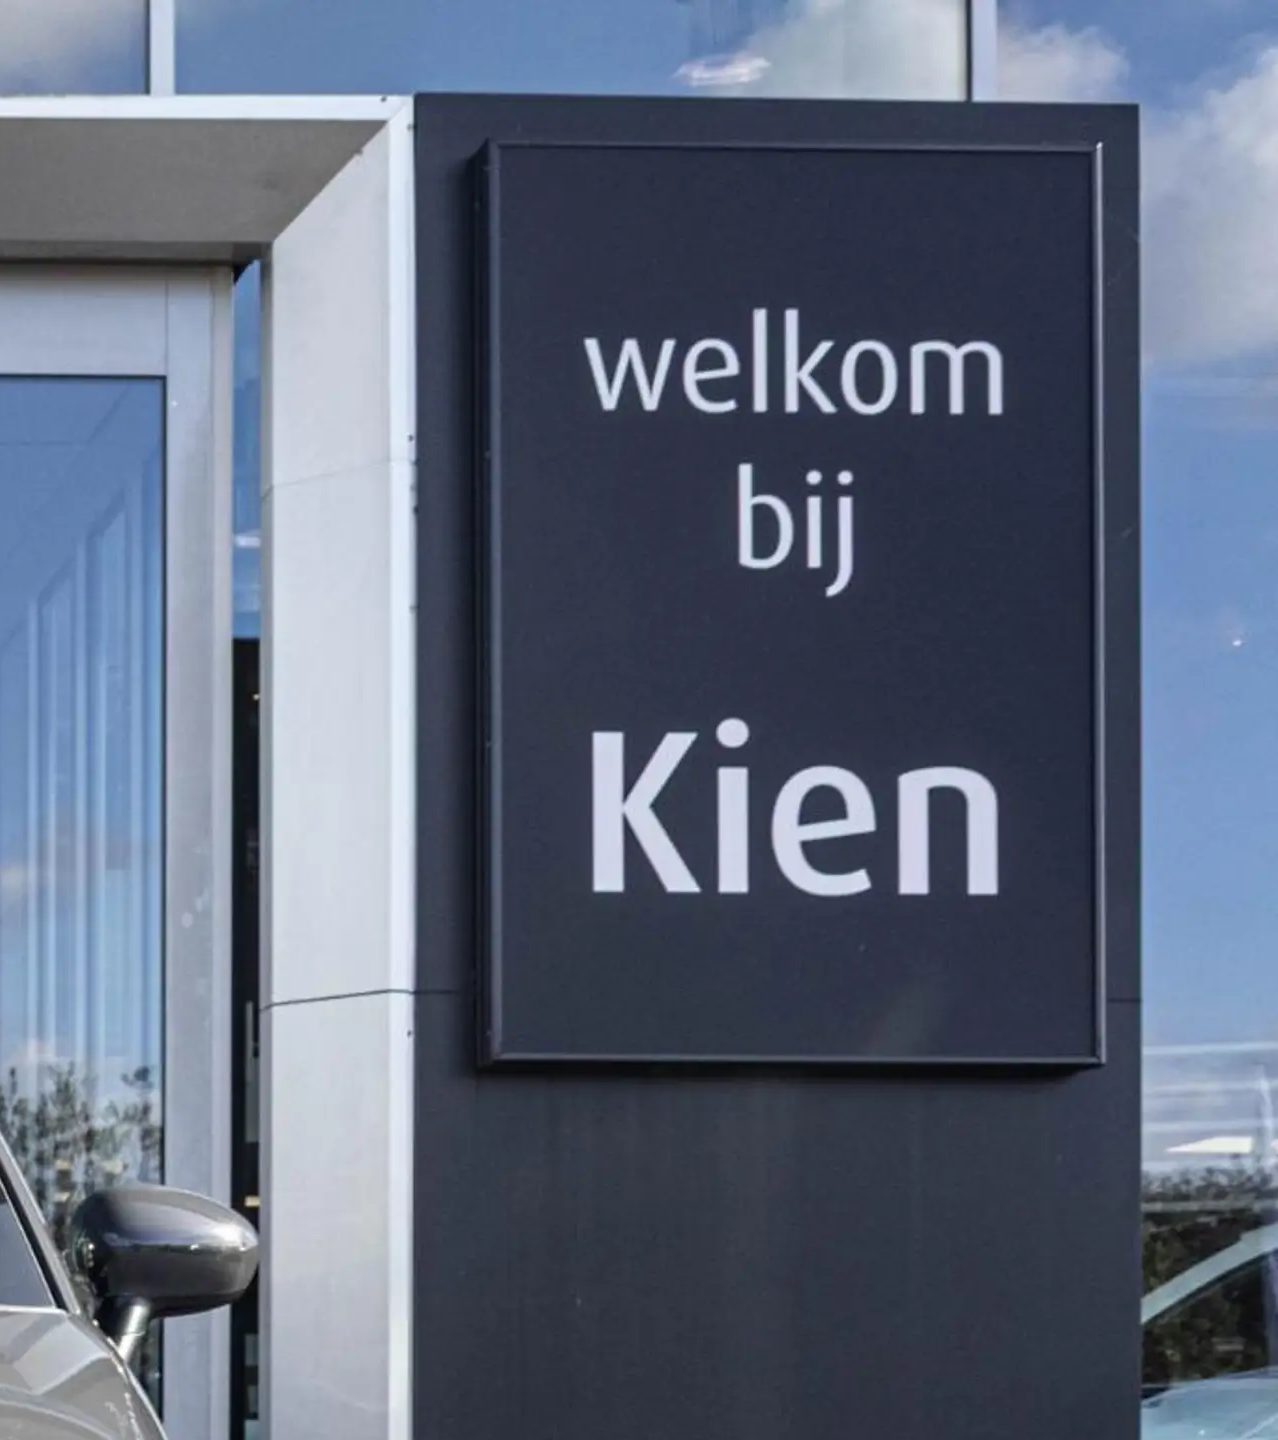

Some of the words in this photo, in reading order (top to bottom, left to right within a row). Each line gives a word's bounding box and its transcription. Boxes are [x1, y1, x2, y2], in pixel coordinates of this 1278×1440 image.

[583, 308, 1004, 416] welkom
[737, 463, 854, 598] bij
[591, 718, 1000, 897] Kien
